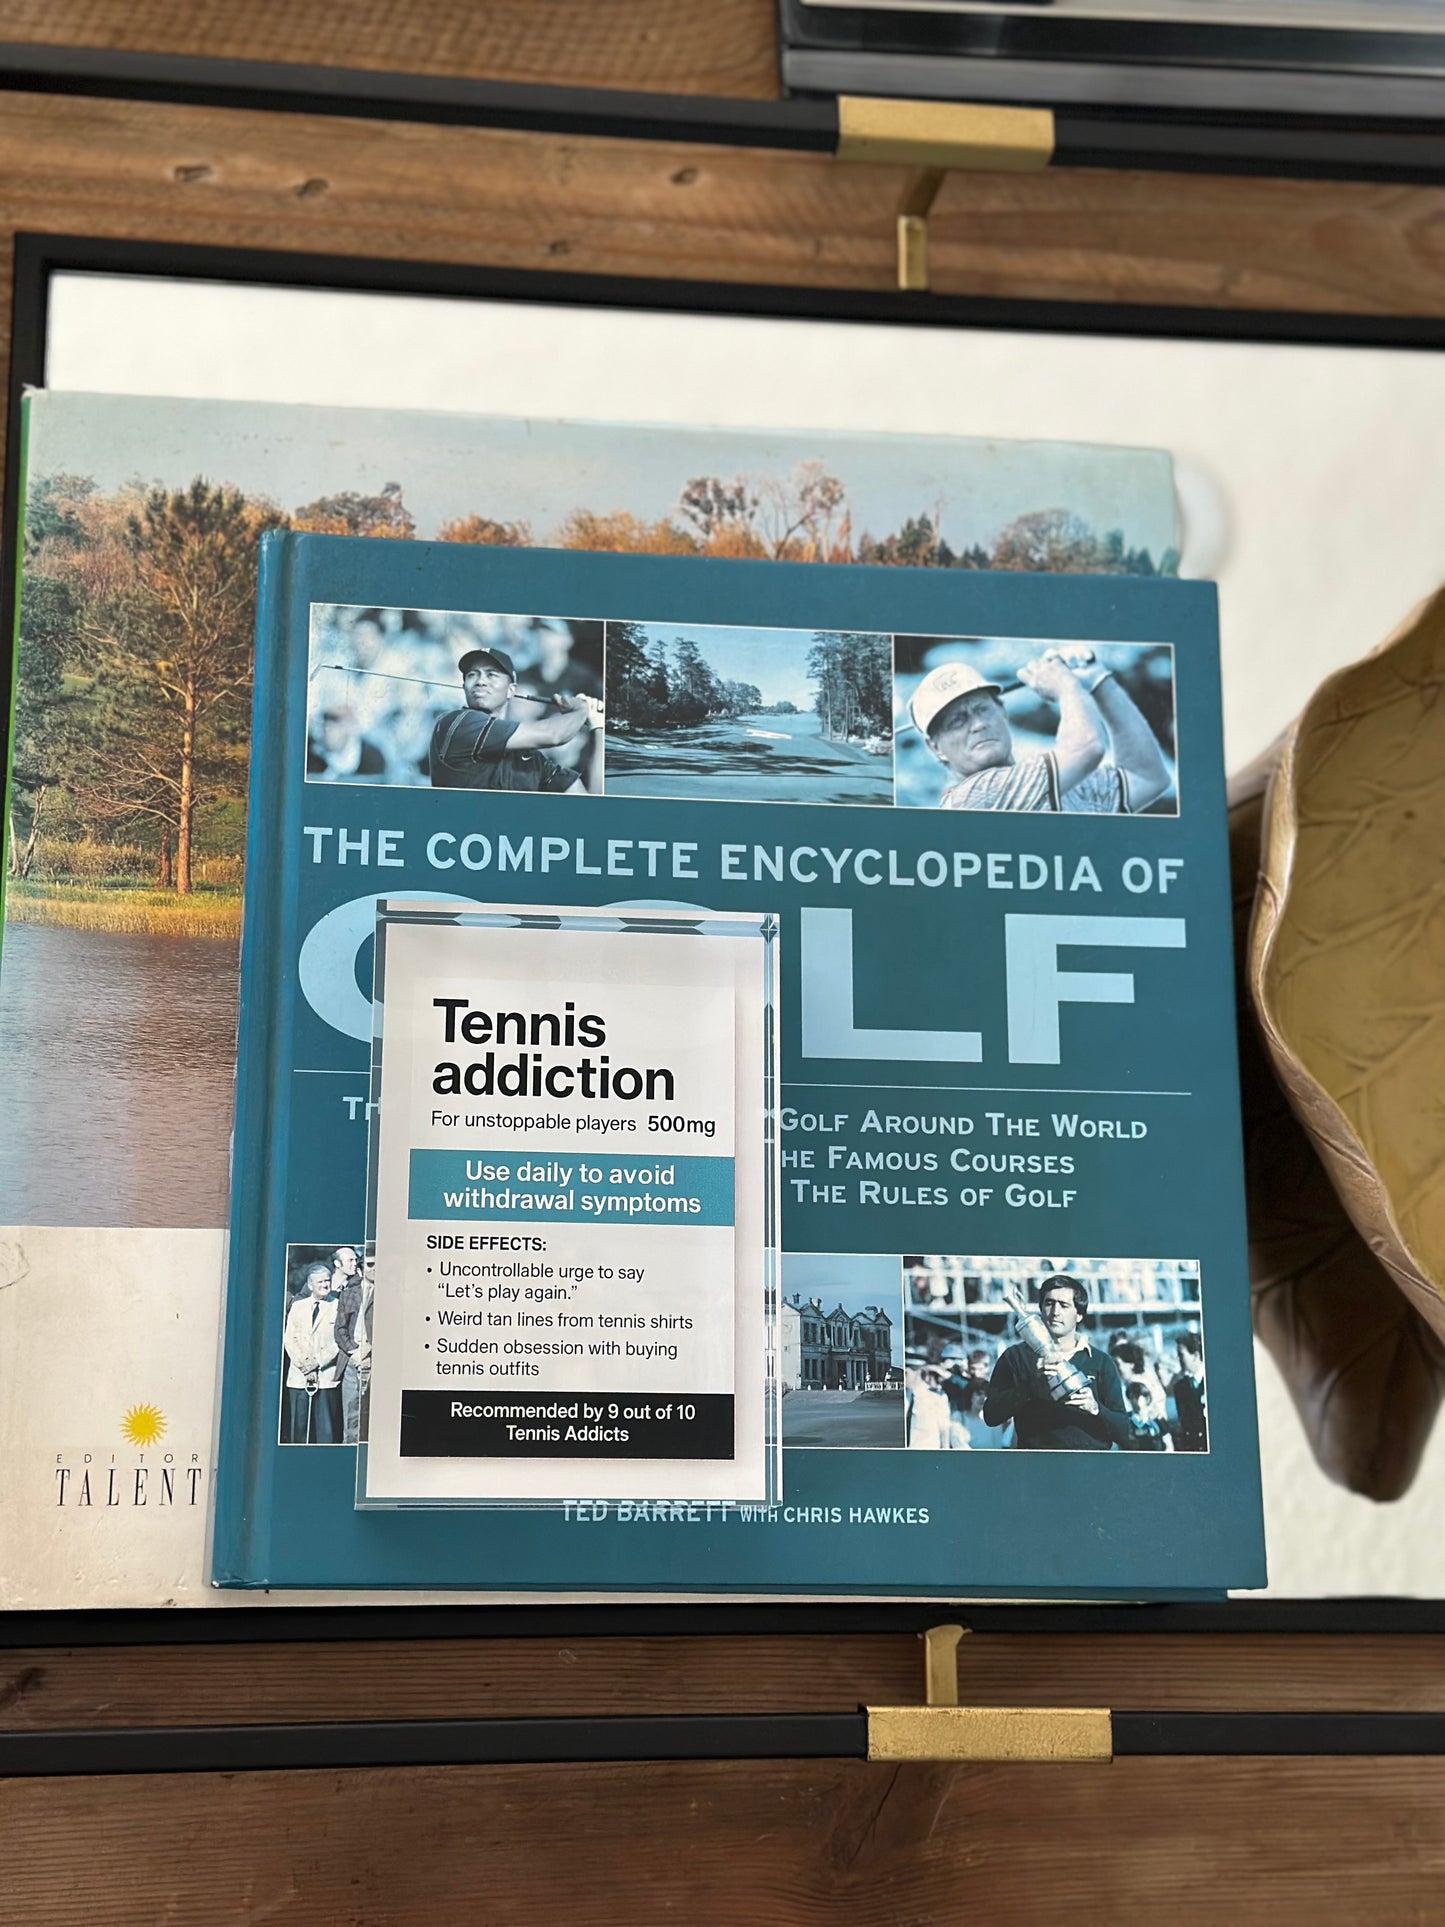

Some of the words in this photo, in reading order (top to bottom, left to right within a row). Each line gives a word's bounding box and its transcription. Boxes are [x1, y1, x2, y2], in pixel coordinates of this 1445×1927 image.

[303, 826, 405, 868] THE
[426, 832, 699, 879] COMPLETE
[720, 843, 1103, 893] ENCYCLOPEDIA
[1121, 857, 1185, 894] OF
[299, 890, 1187, 1065] LF
[433, 998, 606, 1048] Tennis
[432, 1052, 674, 1101] addiction
[432, 1110, 460, 1127] For
[465, 1113, 571, 1132] unstoppable
[576, 1114, 636, 1134] players
[648, 1115, 716, 1138] 500mg
[780, 1107, 849, 1132] GOLF
[859, 1109, 974, 1135] AROUND
[985, 1112, 1040, 1137] THE
[1051, 1114, 1148, 1139] WORLD
[775, 1144, 815, 1169] HE
[828, 1145, 939, 1171] FAMOUS
[950, 1148, 1075, 1174] COURSES
[466, 1160, 510, 1181] Use
[517, 1161, 573, 1187] daily
[579, 1164, 603, 1184] to
[609, 1164, 675, 1186] avoid
[444, 1188, 574, 1211] withdrawal
[580, 1193, 701, 1216] symptoms
[790, 1179, 847, 1204] THE
[859, 1180, 949, 1206] RULES
[960, 1188, 993, 1206] OF
[1005, 1183, 1077, 1208] GOLF
[427, 1235, 464, 1250] SIDE
[469, 1236, 547, 1251] EFFECTS:
[440, 1262, 553, 1279] Uncontrollable
[559, 1267, 594, 1282] urge
[598, 1266, 614, 1279] to
[618, 1268, 644, 1283] say
[488, 1284, 520, 1301] play
[438, 1311, 482, 1326] Weird
[487, 1313, 513, 1327] tan
[517, 1312, 553, 1328] lines
[558, 1313, 593, 1328] from
[598, 1315, 645, 1329] tennis
[650, 1315, 693, 1329] shirts
[437, 1339, 498, 1354] Sudden
[503, 1341, 583, 1355] obsession
[589, 1341, 620, 1356] with
[625, 1342, 678, 1360] buying
[436, 1362, 484, 1375] tennis
[489, 1361, 539, 1376] outfits
[451, 1403, 578, 1419] Recommended
[583, 1404, 603, 1422] by
[608, 1404, 618, 1419] 9
[623, 1405, 651, 1420] out
[655, 1404, 672, 1420] of
[677, 1404, 696, 1420] 10
[506, 1425, 560, 1440] Tennis
[565, 1426, 629, 1442] Addicts
[56, 1453, 199, 1464] EDITOR
[55, 1468, 201, 1506] TALENT
[563, 1500, 608, 1522] TED
[617, 1500, 736, 1523] BARRETT
[740, 1506, 778, 1523] WITH
[783, 1507, 842, 1524] CHRIS
[849, 1507, 930, 1524] HAWKES
